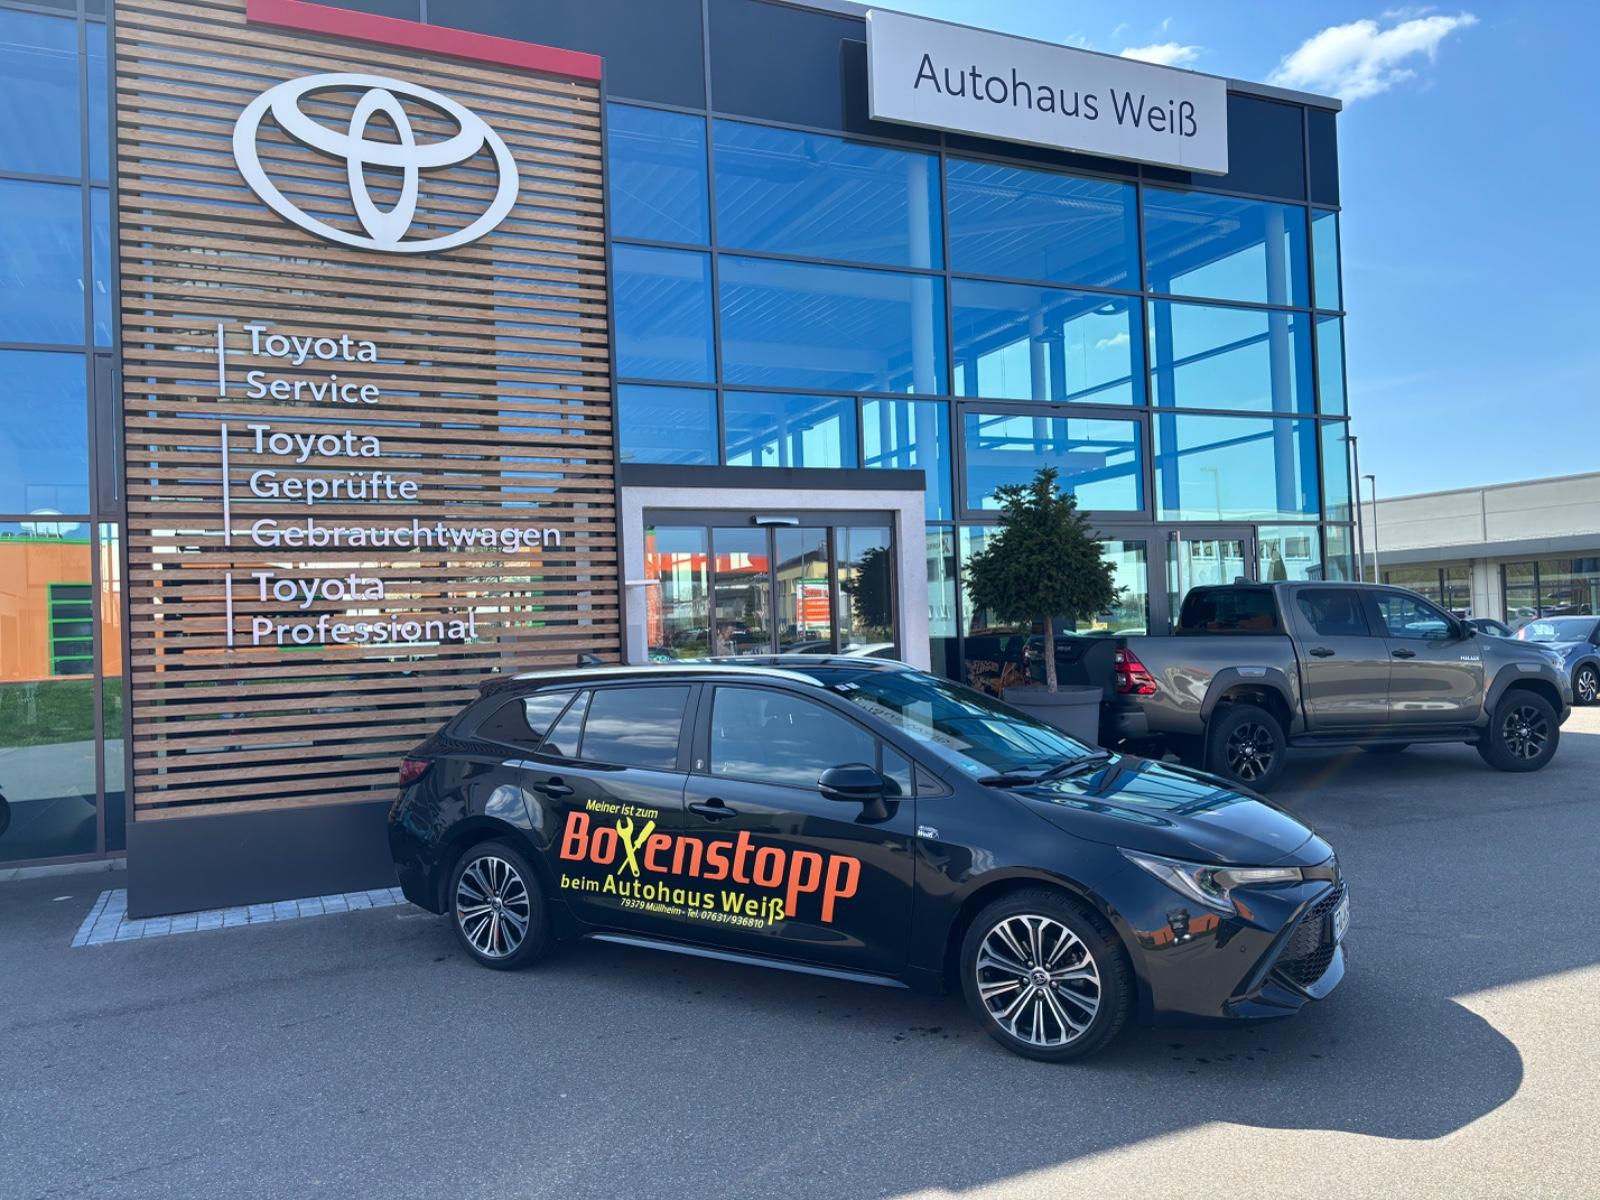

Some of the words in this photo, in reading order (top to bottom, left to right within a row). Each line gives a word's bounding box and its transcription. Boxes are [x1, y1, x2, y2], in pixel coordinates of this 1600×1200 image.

[913, 53, 1100, 121] Autohaus
[1110, 88, 1198, 137] Weiß
[244, 325, 378, 365] Toyota
[246, 371, 380, 404] Service
[247, 424, 381, 463] Toyota
[249, 470, 419, 505] Geprüfte
[250, 518, 562, 553] Gebrauchtwagen
[251, 572, 385, 609] Toyota
[252, 612, 479, 646] Professional
[585, 799, 620, 814] Meiner
[621, 803, 635, 816] ist
[634, 807, 659, 819] zum
[560, 873, 600, 892] beim
[602, 875, 716, 910] Autohaus
[720, 890, 786, 926] Weiß
[620, 897, 646, 910] 79379
[700, 912, 764, 929] 07631/936810
